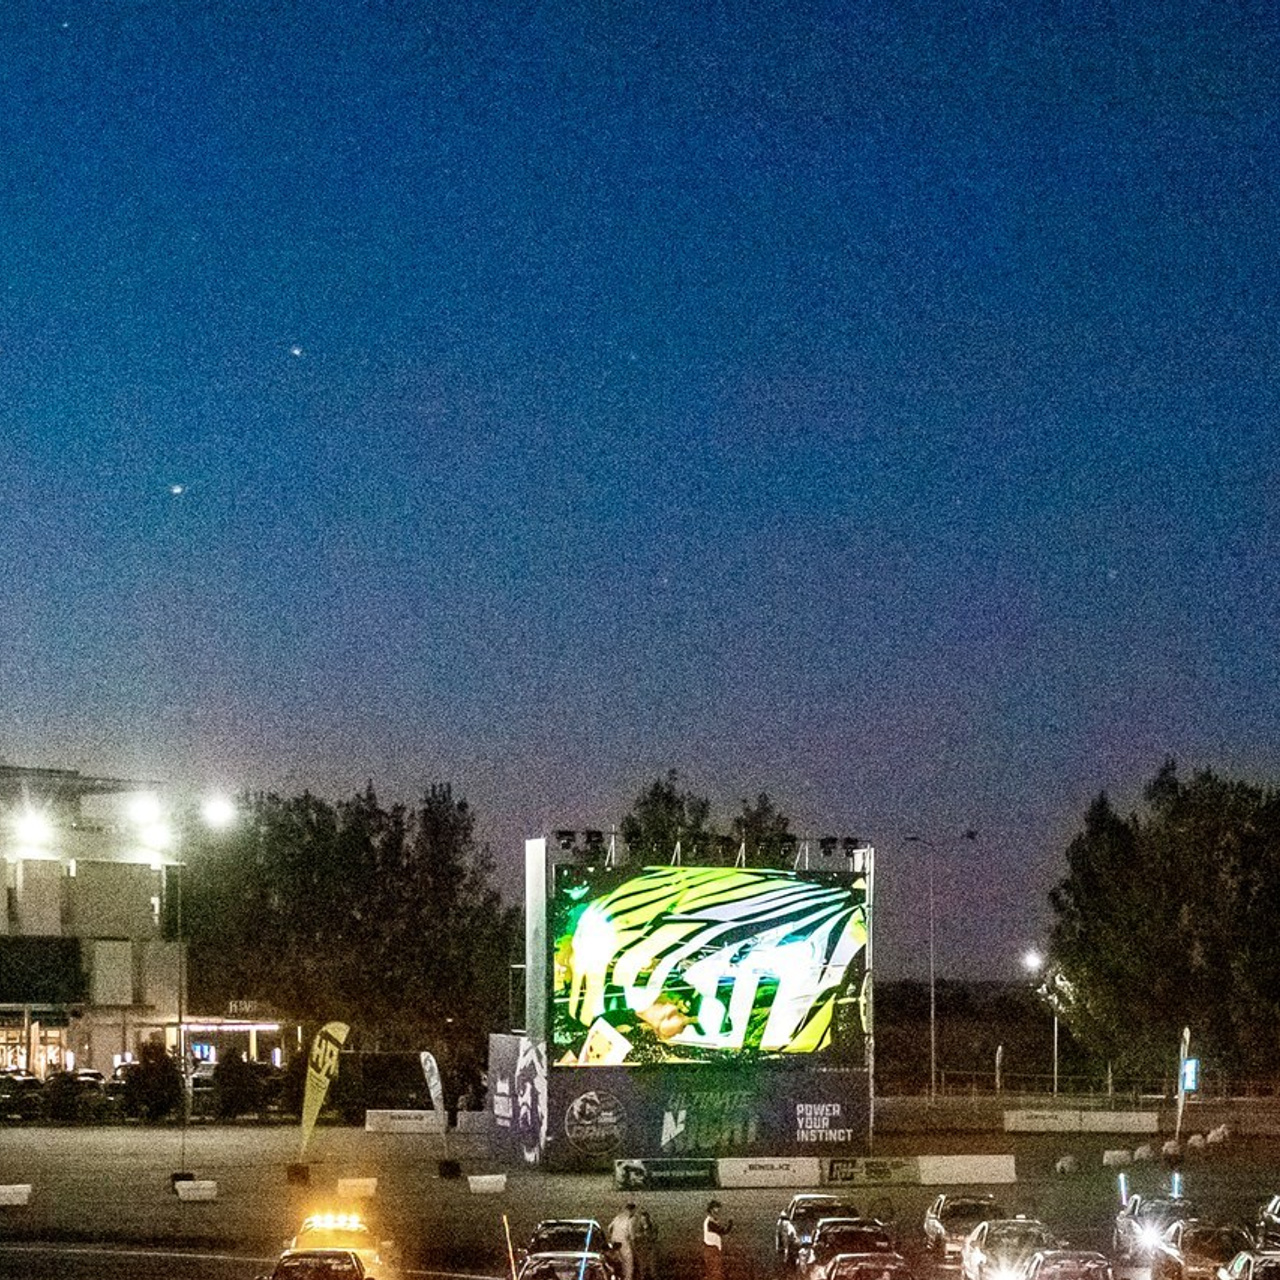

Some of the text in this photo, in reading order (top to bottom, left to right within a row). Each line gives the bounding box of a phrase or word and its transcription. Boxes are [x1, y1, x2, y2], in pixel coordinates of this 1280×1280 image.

[796, 1103, 841, 1116] POWER
[796, 1117, 831, 1129] YOUR
[796, 1129, 854, 1142] INSTINCT
